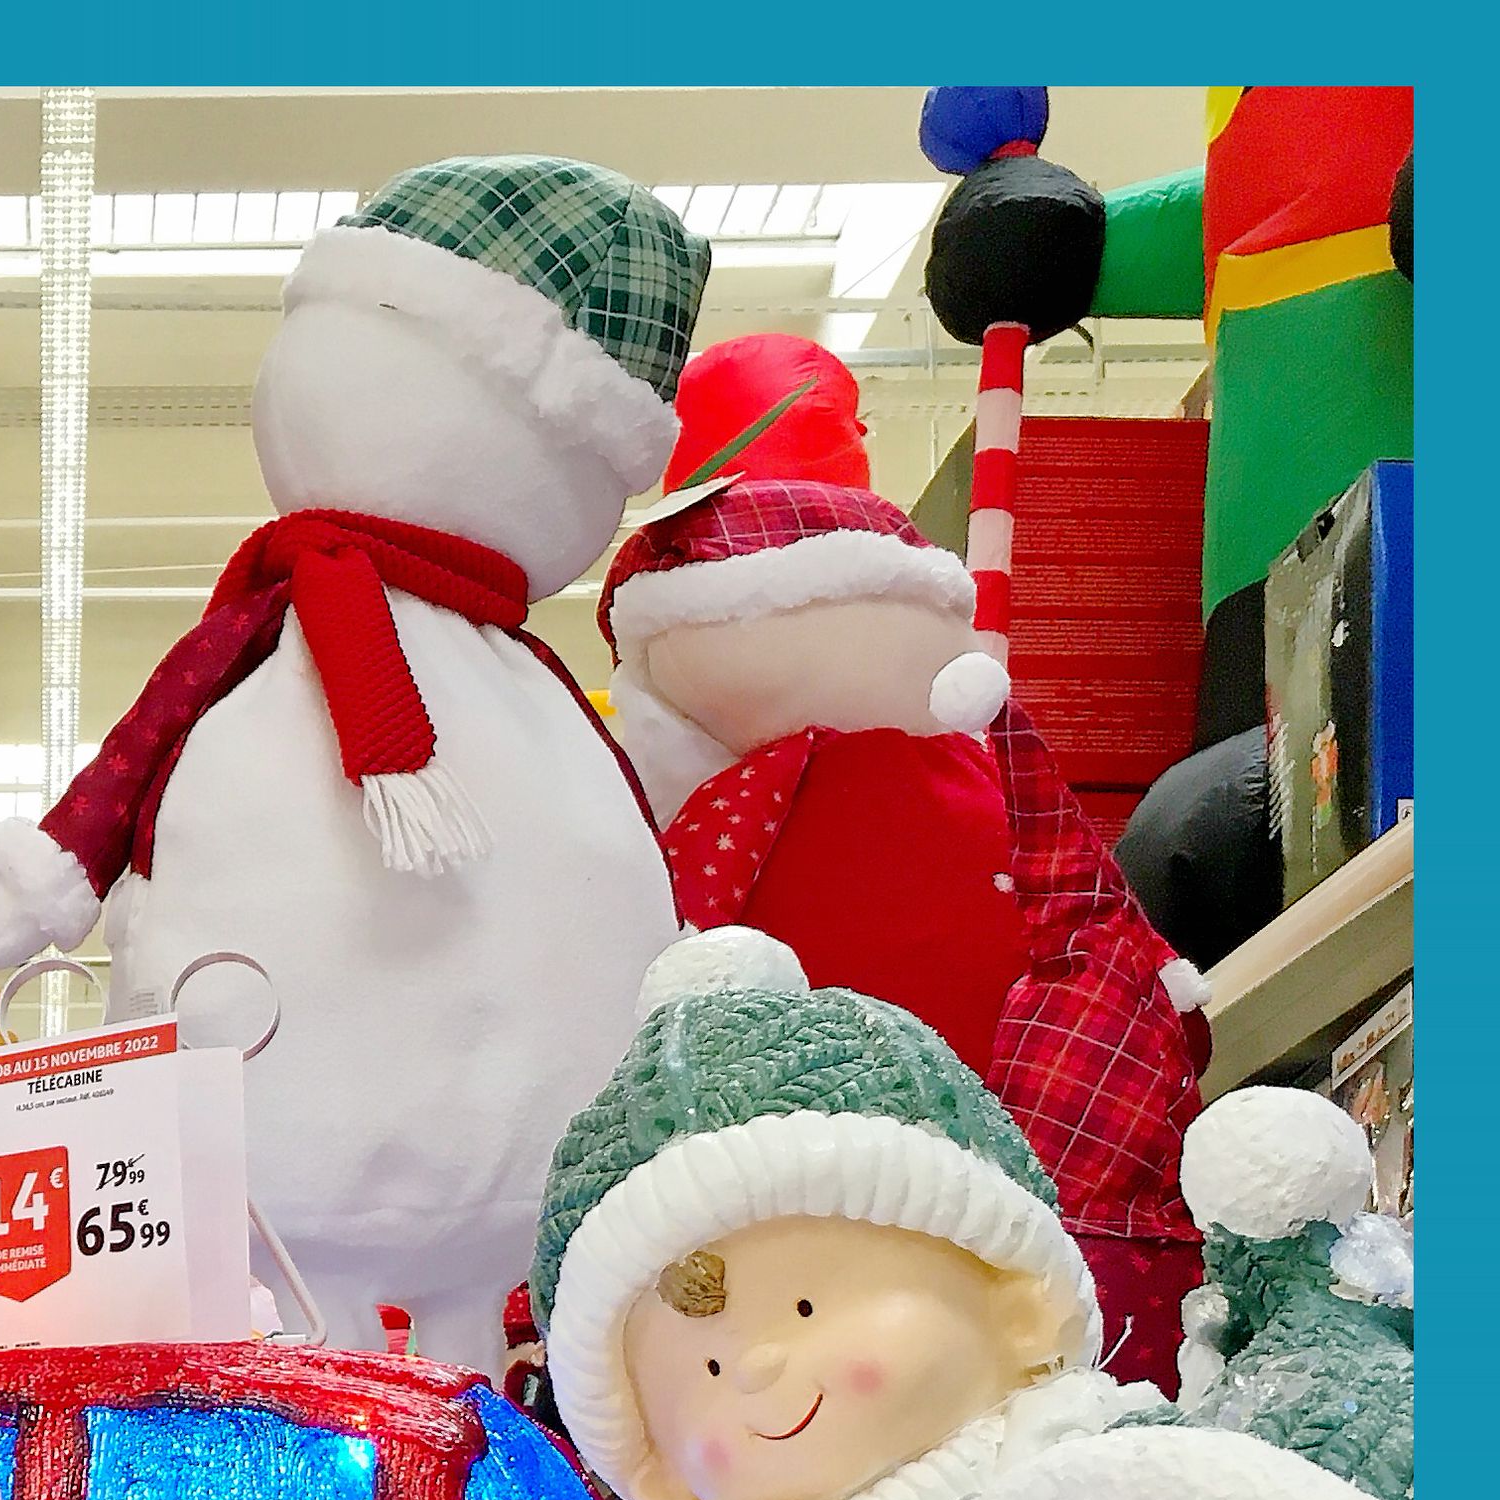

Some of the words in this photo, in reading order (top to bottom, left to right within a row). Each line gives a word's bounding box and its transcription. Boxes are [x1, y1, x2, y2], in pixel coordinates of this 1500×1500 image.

[12, 1059, 31, 1074] AU
[33, 1056, 48, 1071] 15
[49, 1041, 121, 1068] NOVEMBRE
[124, 1035, 159, 1054] 2022
[26, 1068, 103, 1095] TÉLÉCABINE
[9, 1243, 44, 1259] REMISE
